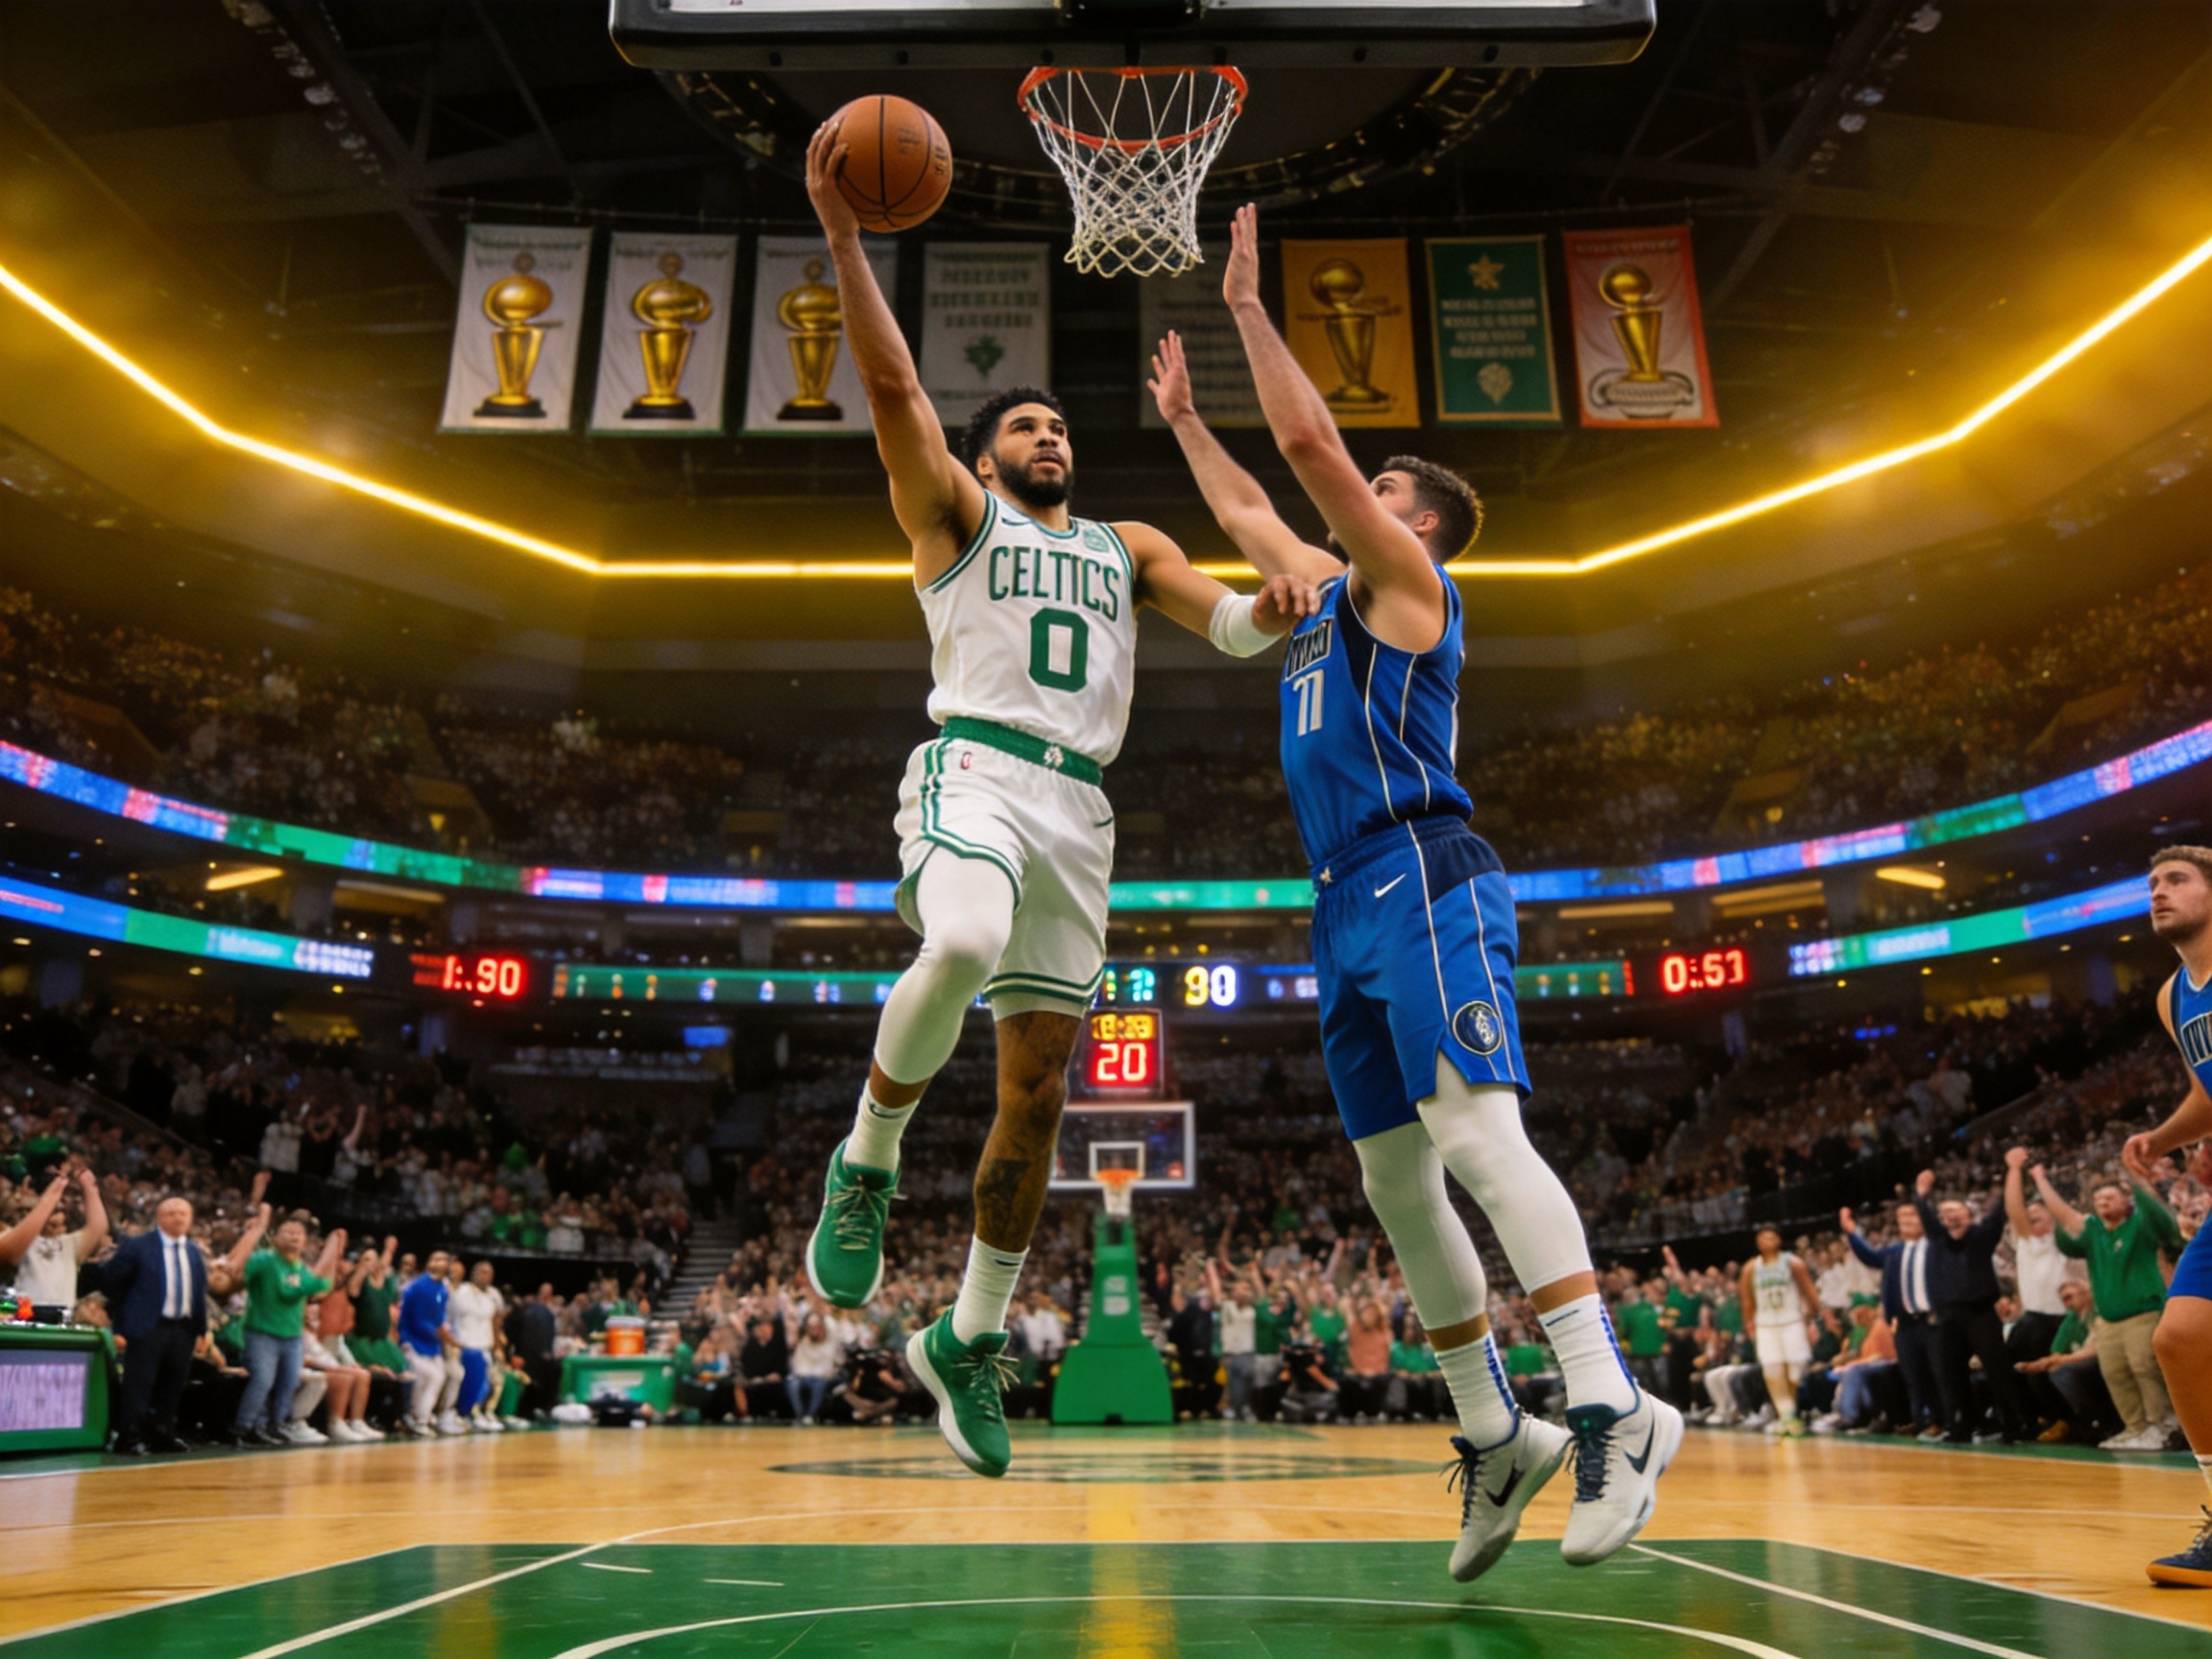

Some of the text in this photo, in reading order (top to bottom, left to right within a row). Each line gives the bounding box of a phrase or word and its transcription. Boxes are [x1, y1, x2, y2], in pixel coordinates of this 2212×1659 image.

[988, 545, 1120, 622] CELTICS
[1028, 607, 1090, 693] 0
[1184, 965, 1237, 1006] 90
[1096, 1042, 1147, 1082] 20
